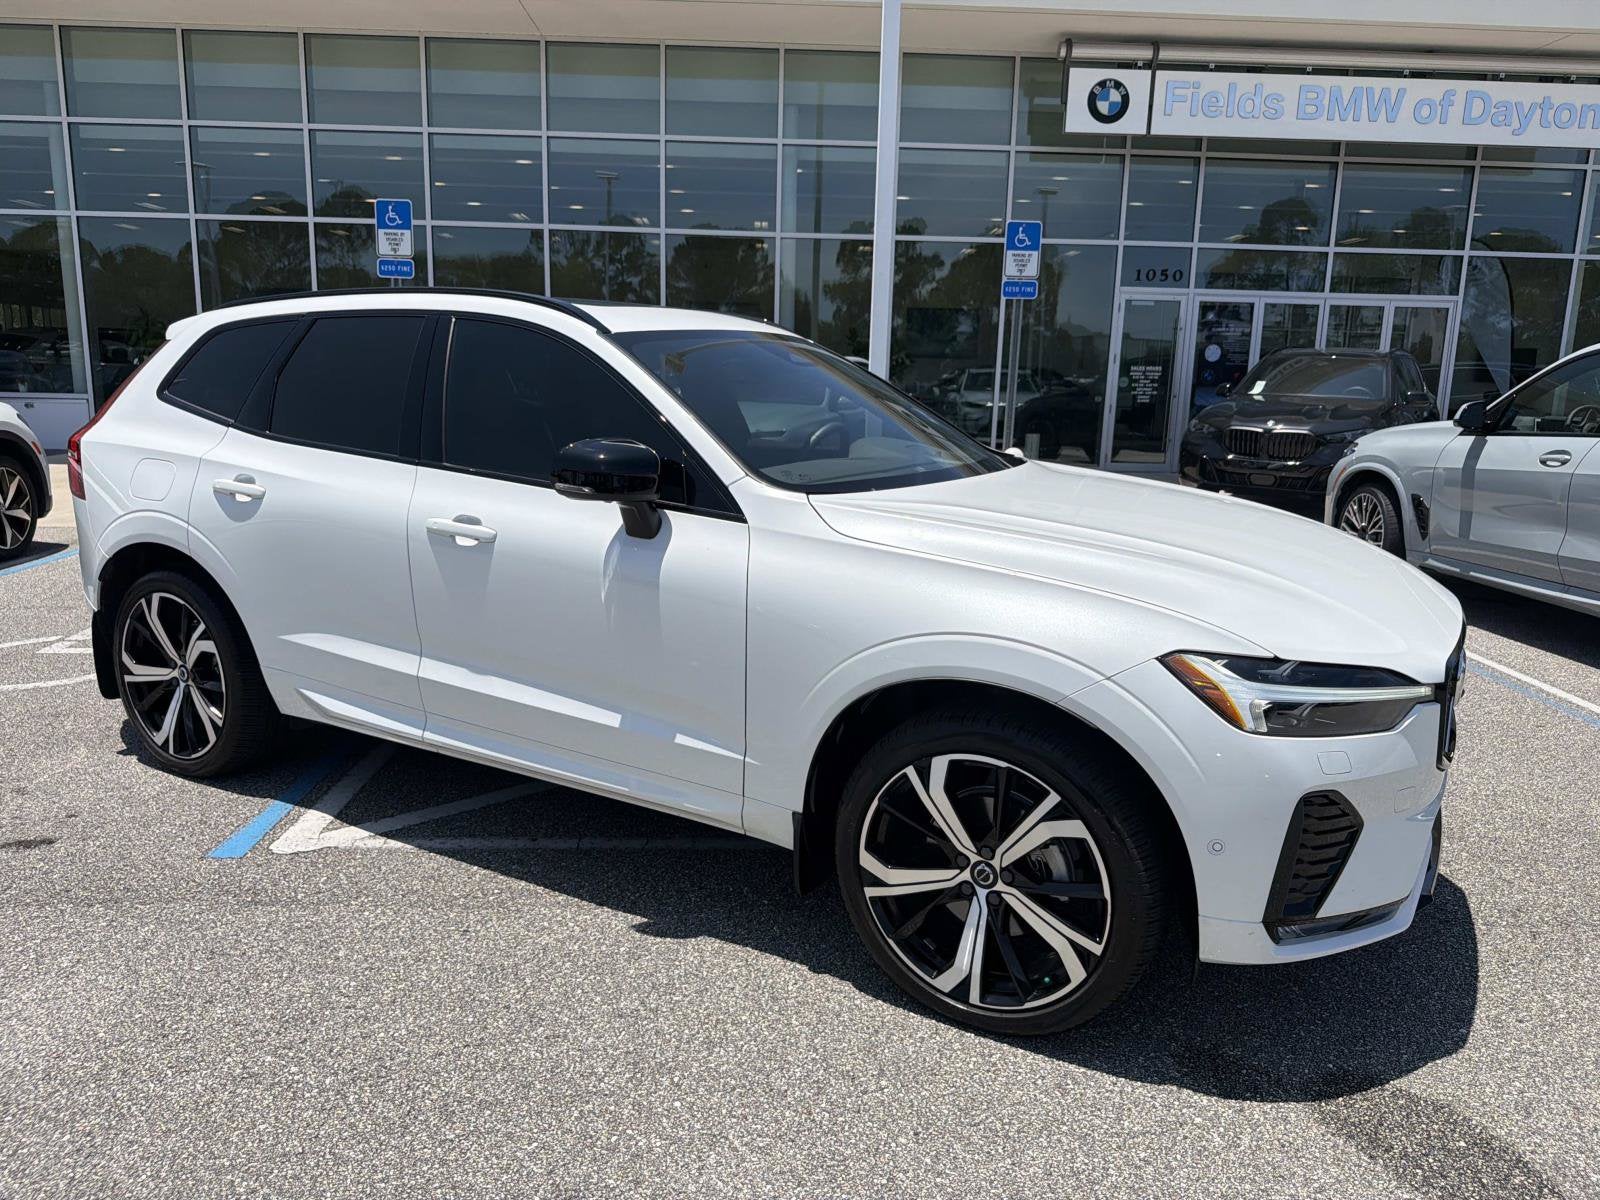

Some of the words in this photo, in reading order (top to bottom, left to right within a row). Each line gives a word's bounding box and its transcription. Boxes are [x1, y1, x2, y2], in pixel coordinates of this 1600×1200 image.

[1093, 80, 1127, 96] BMW
[1163, 80, 1285, 120] Fields
[1296, 84, 1407, 123] BMW
[1413, 88, 1457, 125] of
[1462, 90, 1600, 136] Dayton
[1135, 268, 1184, 282] 1050
